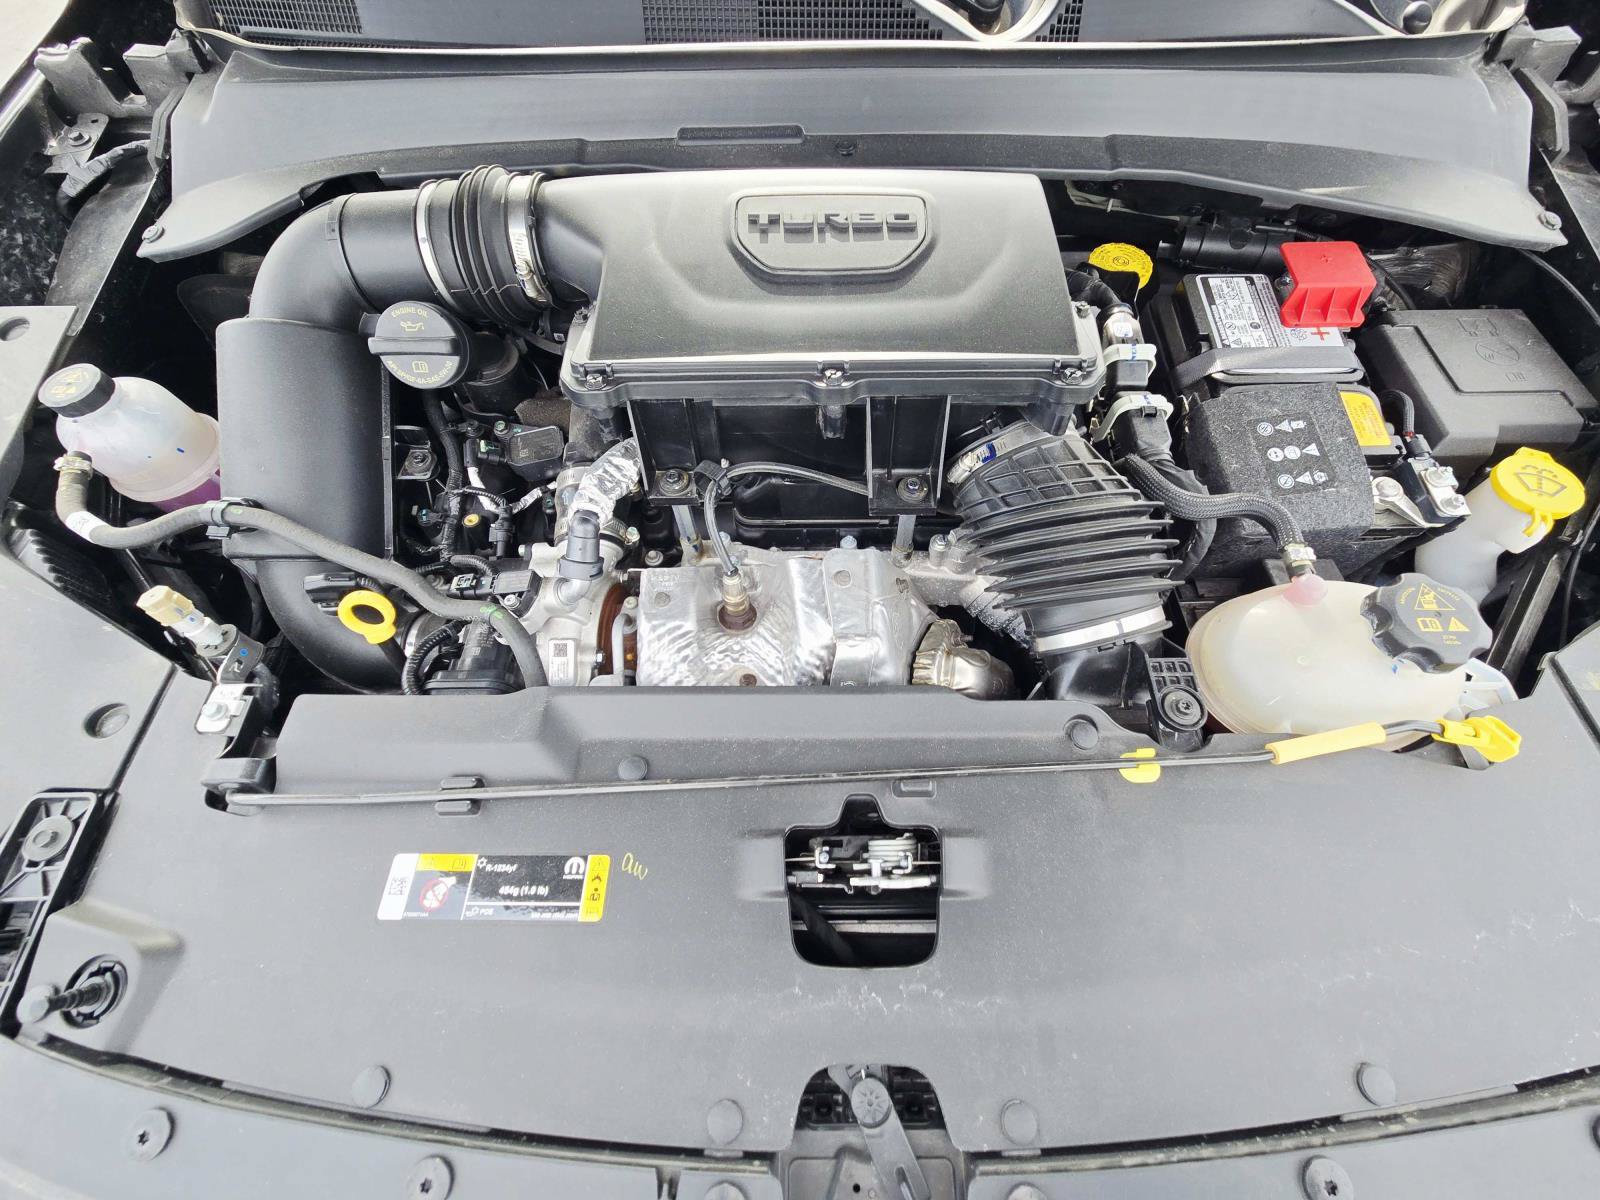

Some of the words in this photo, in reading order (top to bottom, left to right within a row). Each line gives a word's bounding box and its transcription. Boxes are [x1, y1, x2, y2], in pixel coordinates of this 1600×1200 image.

[747, 207, 919, 243] TURBO
[391, 306, 417, 318] ENGINE
[417, 308, 429, 318] OIL
[498, 885, 520, 897] 454g
